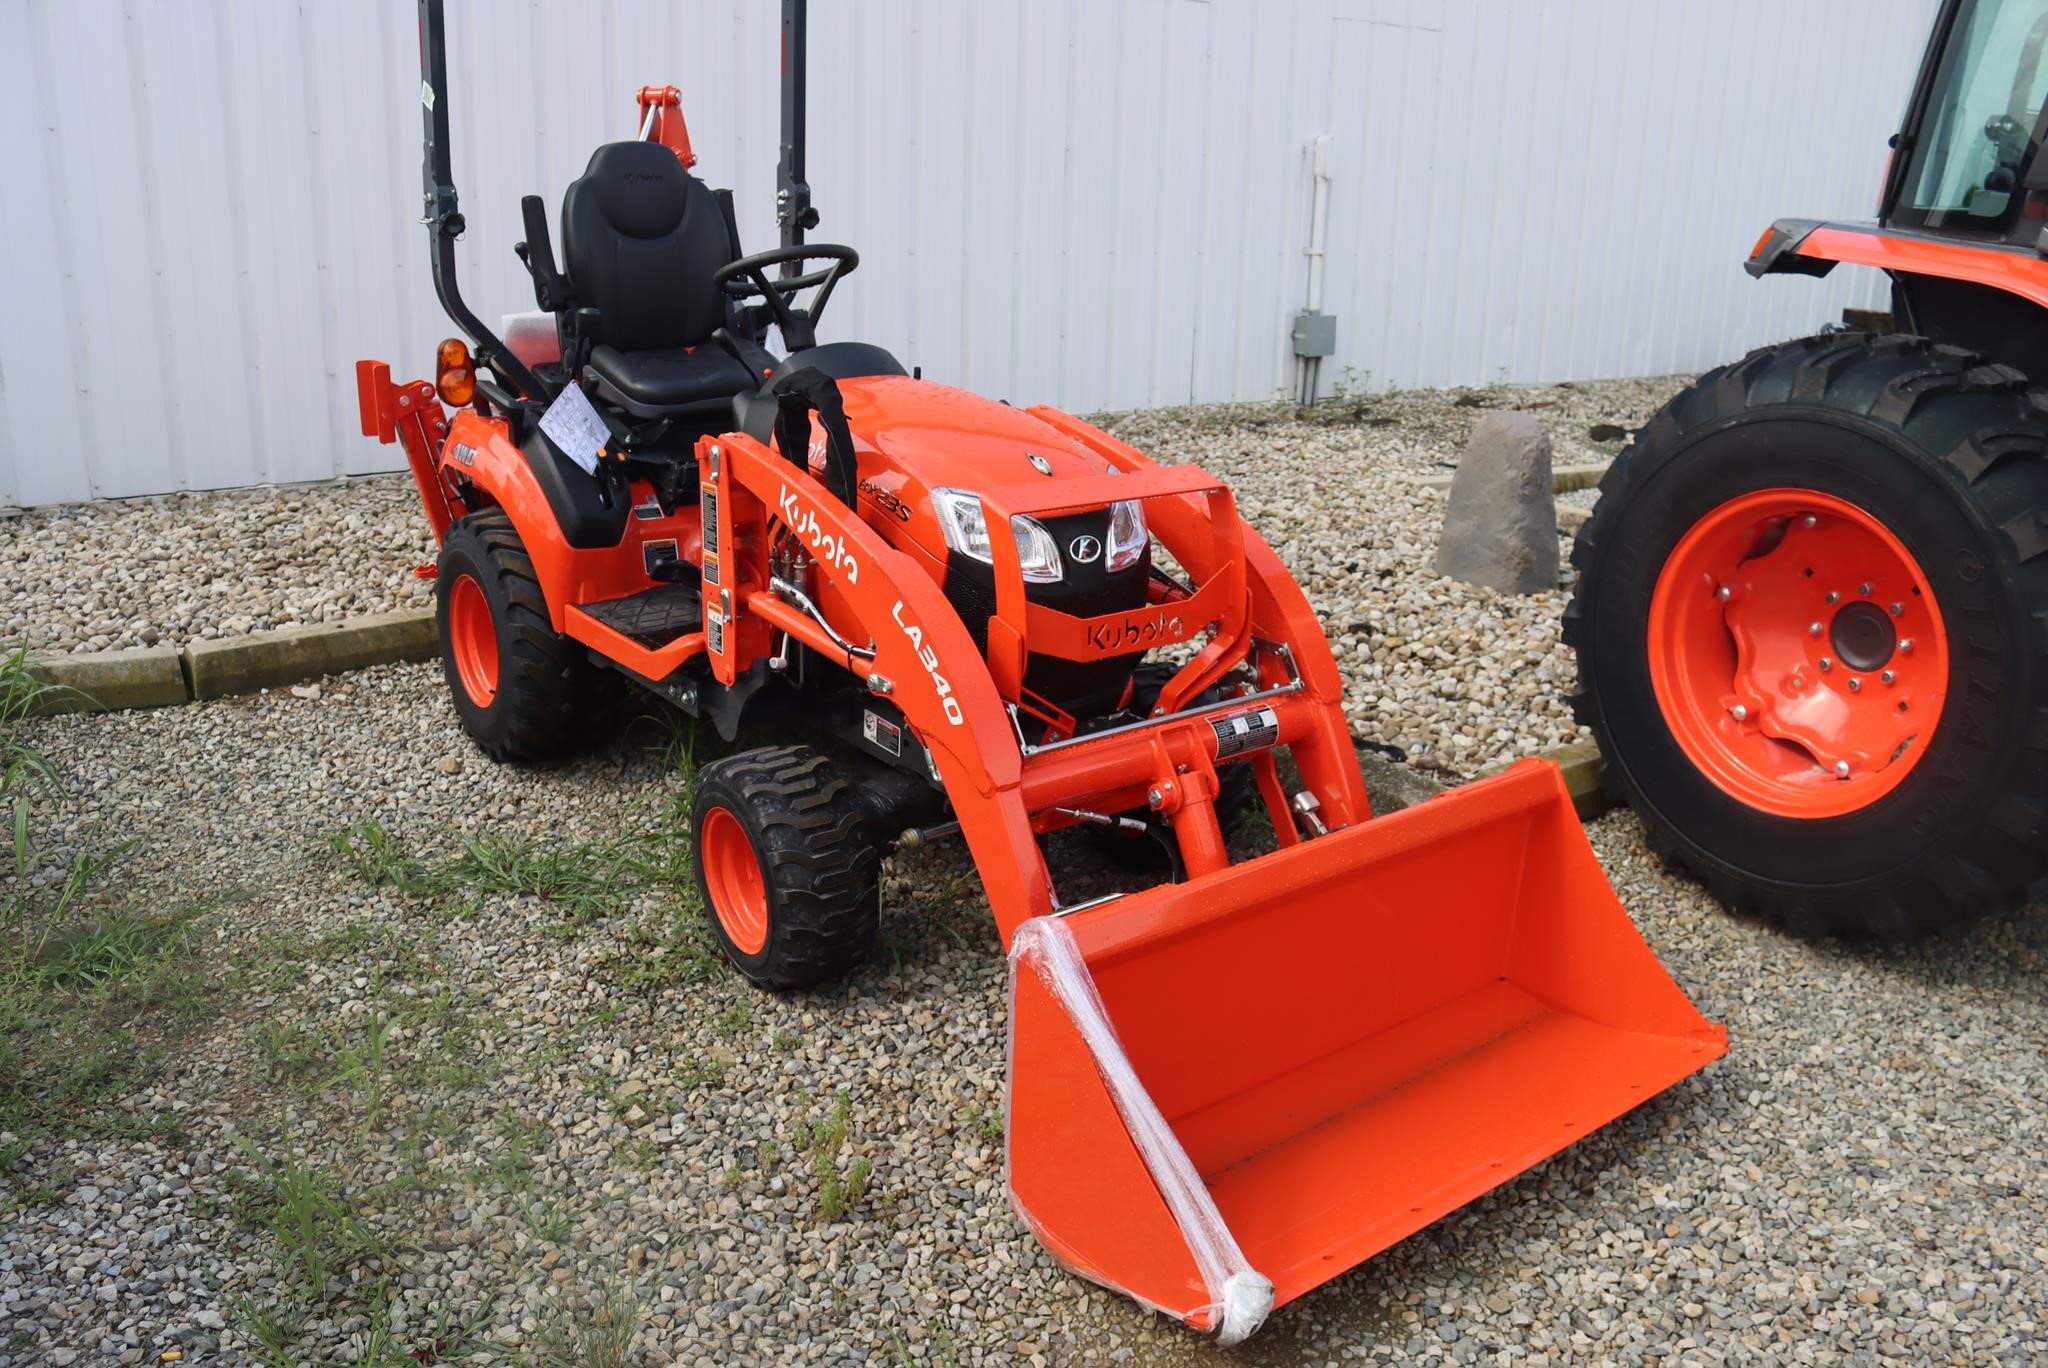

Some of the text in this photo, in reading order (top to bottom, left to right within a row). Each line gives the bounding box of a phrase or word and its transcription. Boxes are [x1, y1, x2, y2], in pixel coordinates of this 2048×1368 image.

[779, 483, 858, 585] Kubota
[858, 479, 913, 522] BX23S
[892, 600, 963, 725] LA340
[1087, 611, 1183, 650] Kubota
